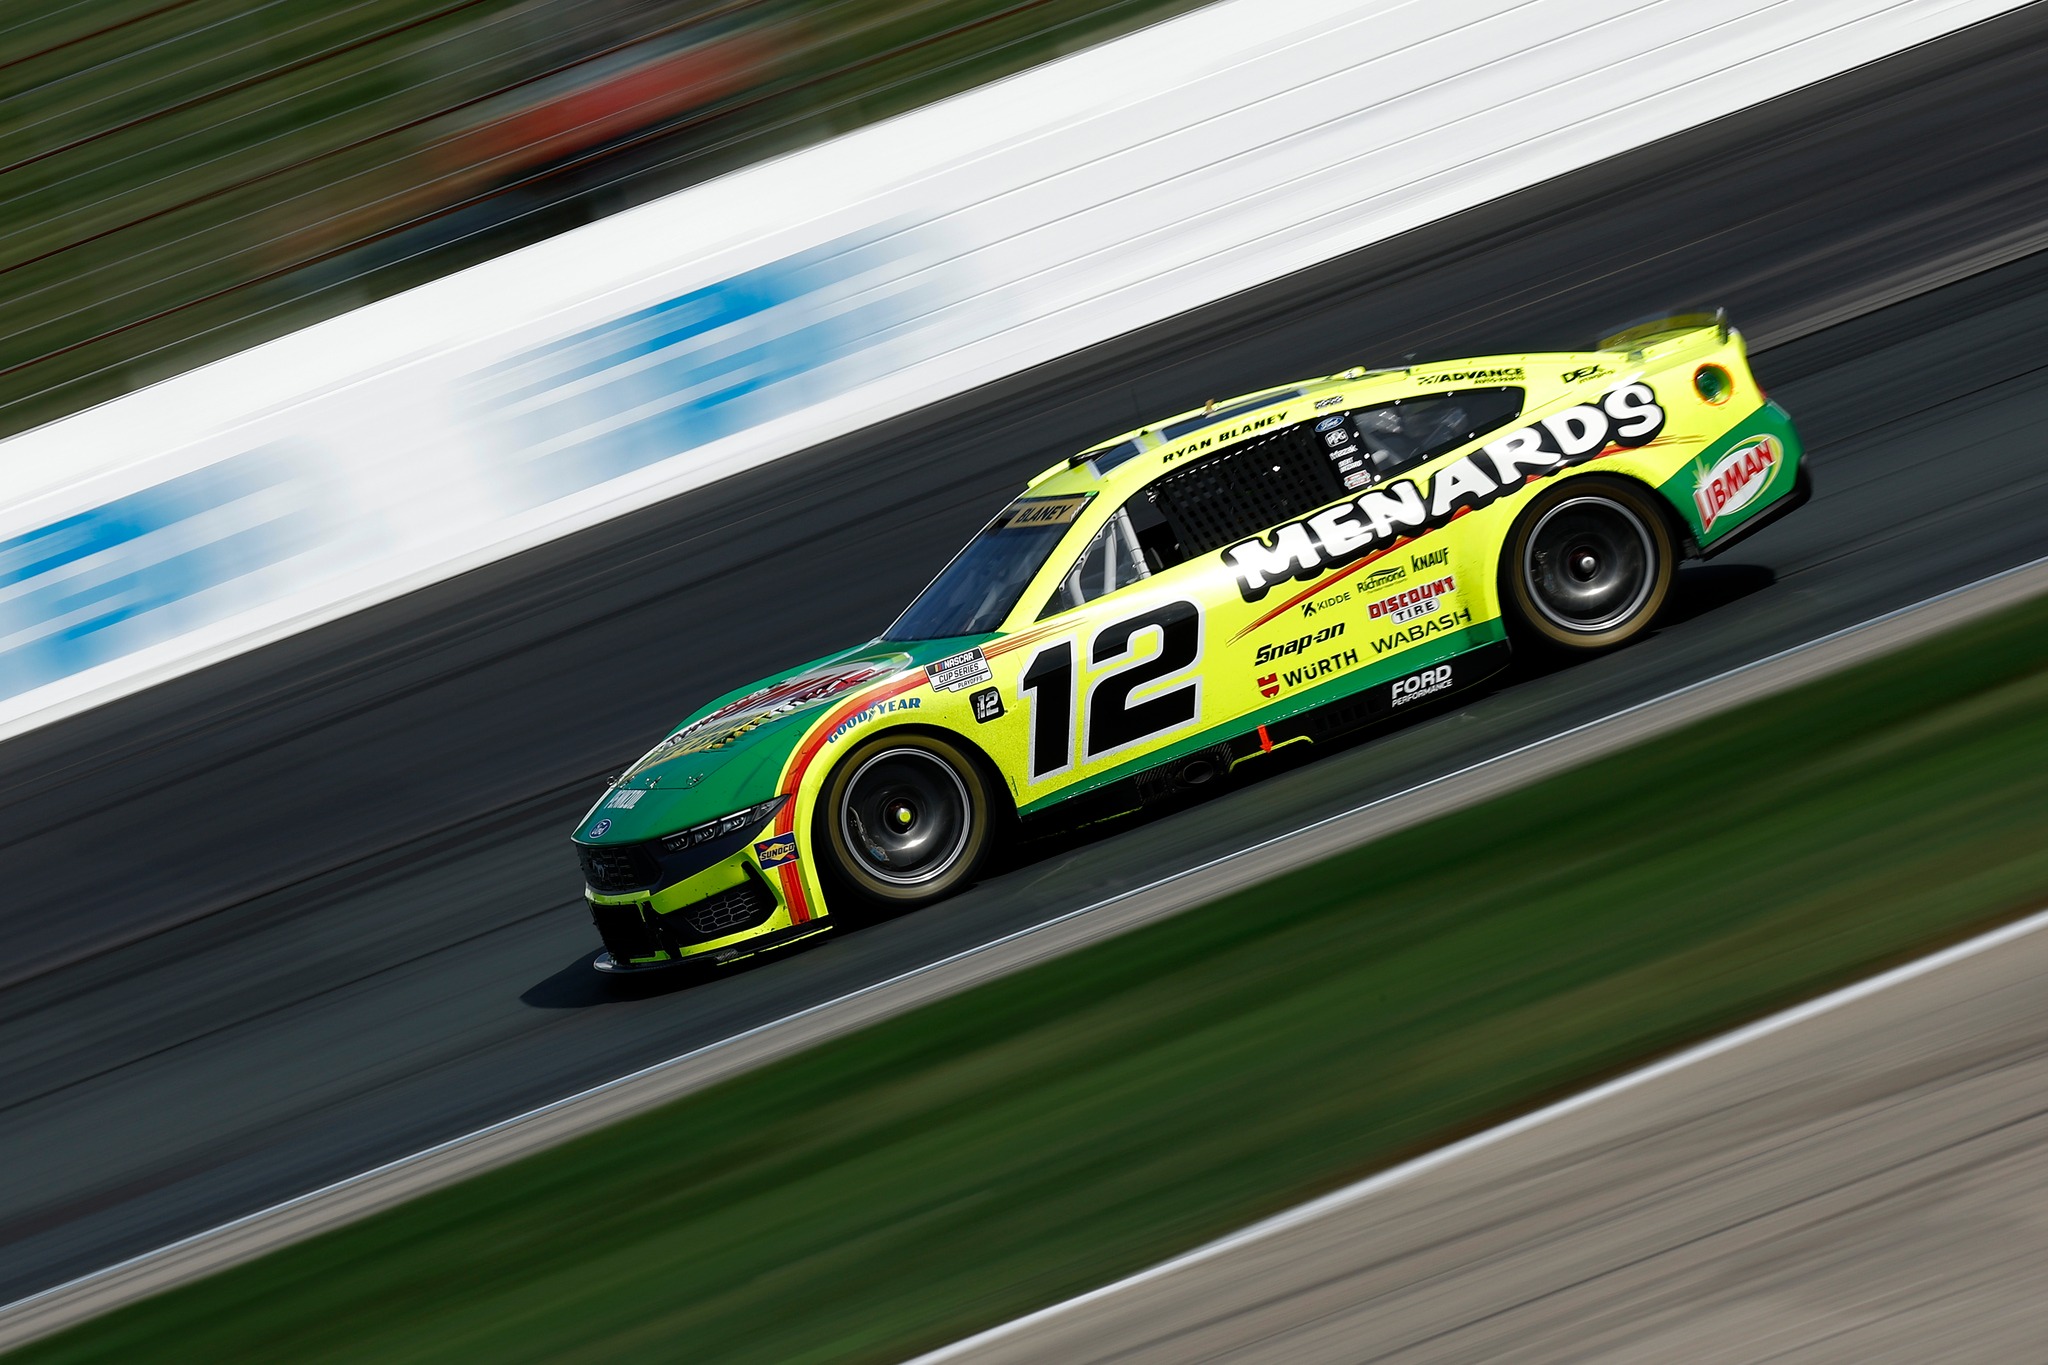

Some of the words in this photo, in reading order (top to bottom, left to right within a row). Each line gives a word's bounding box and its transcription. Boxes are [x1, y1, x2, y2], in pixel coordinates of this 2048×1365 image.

[1440, 367, 1525, 383] ADVANCE
[1163, 438, 1212, 464] RYAN
[1219, 410, 1288, 442] BLANEY
[1223, 383, 1665, 600] MENARDS
[1694, 438, 1774, 533] LIBMAN
[1014, 503, 1074, 525] BLANEY
[1411, 547, 1449, 573] KNAUF
[1356, 566, 1406, 593] Richmond
[1317, 591, 1350, 611] KIDDE
[1367, 575, 1456, 620] DISCOUNT
[1395, 600, 1435, 621] TIRE
[1254, 622, 1345, 667] Snap-on
[1371, 607, 1473, 654] WABASH
[938, 671, 954, 684] CUP
[954, 663, 979, 678] SERIES
[944, 652, 974, 669] NASCAR
[1283, 648, 1359, 687] WÜRTH
[958, 675, 983, 688] PLAYOFFS
[1020, 597, 1203, 783] 12
[1391, 664, 1452, 700] FORD
[1391, 679, 1453, 708] PERFORMANCE
[978, 690, 1000, 719] 12
[760, 842, 795, 861] SUNOCO
